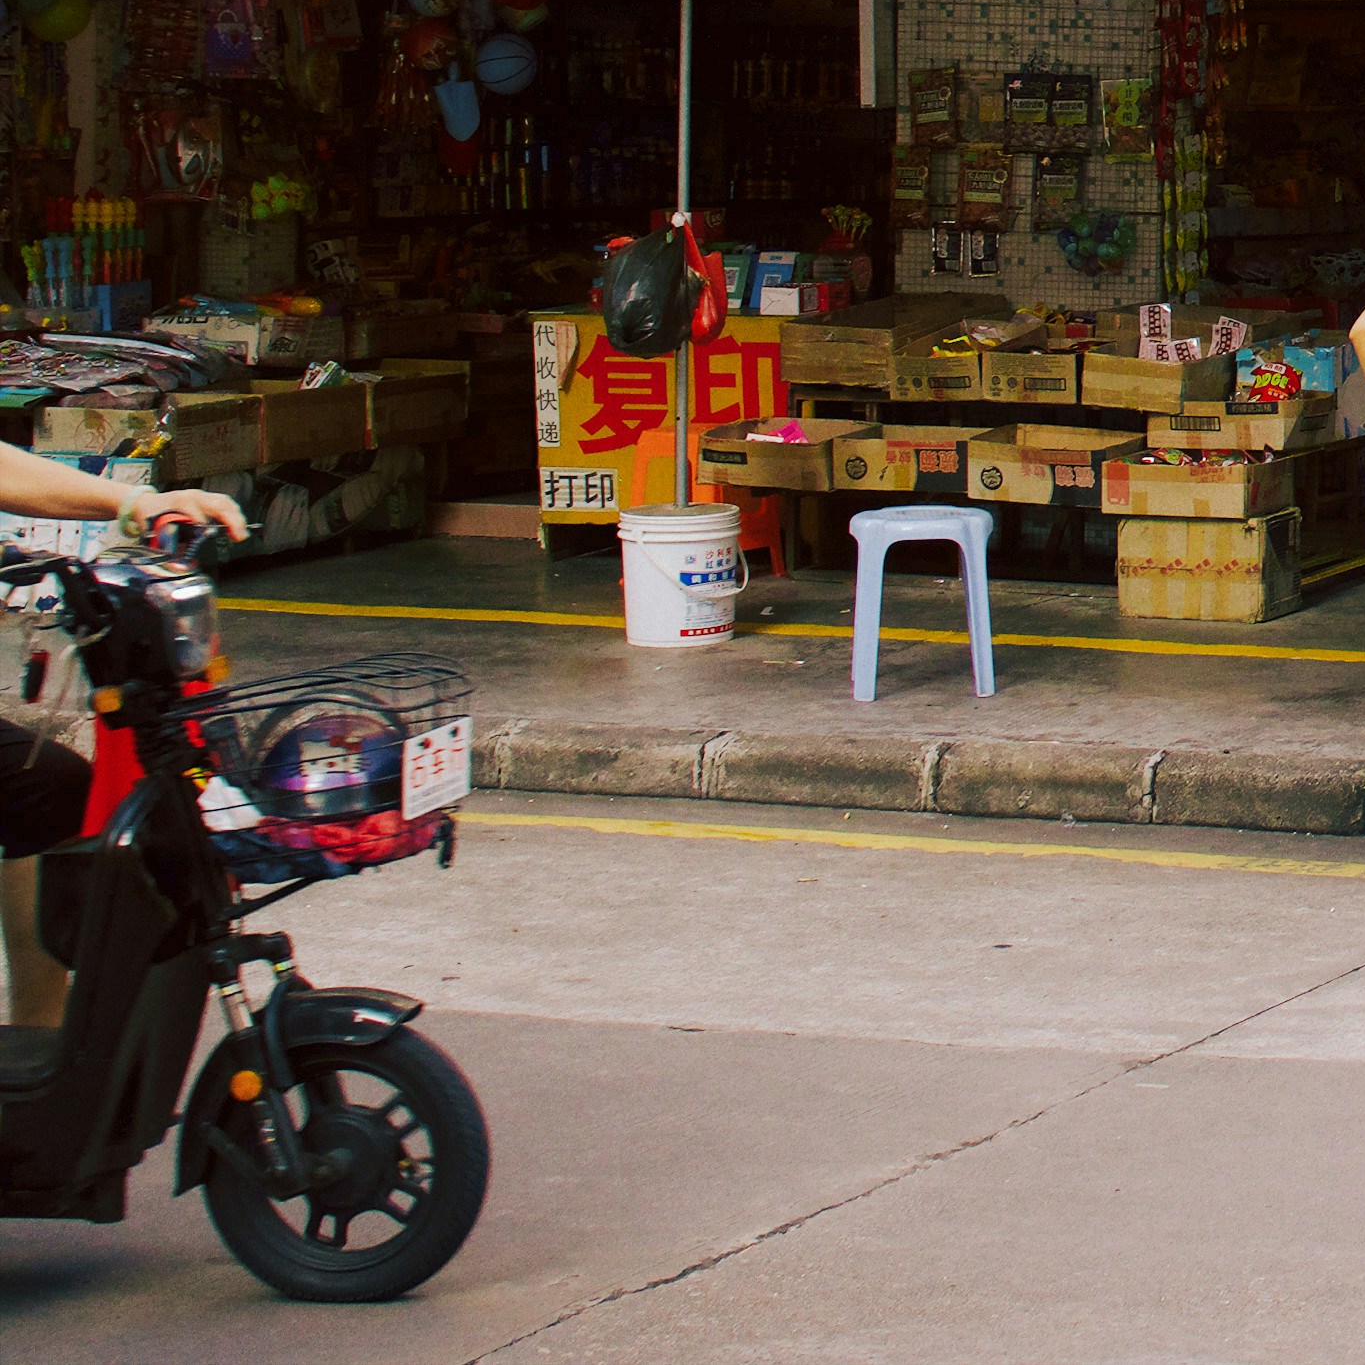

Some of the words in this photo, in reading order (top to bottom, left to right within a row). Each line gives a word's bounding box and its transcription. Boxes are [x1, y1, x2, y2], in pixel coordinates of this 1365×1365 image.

[534, 323, 561, 444] 代收快递
[576, 333, 790, 455] 复印
[544, 470, 615, 509] 打印
